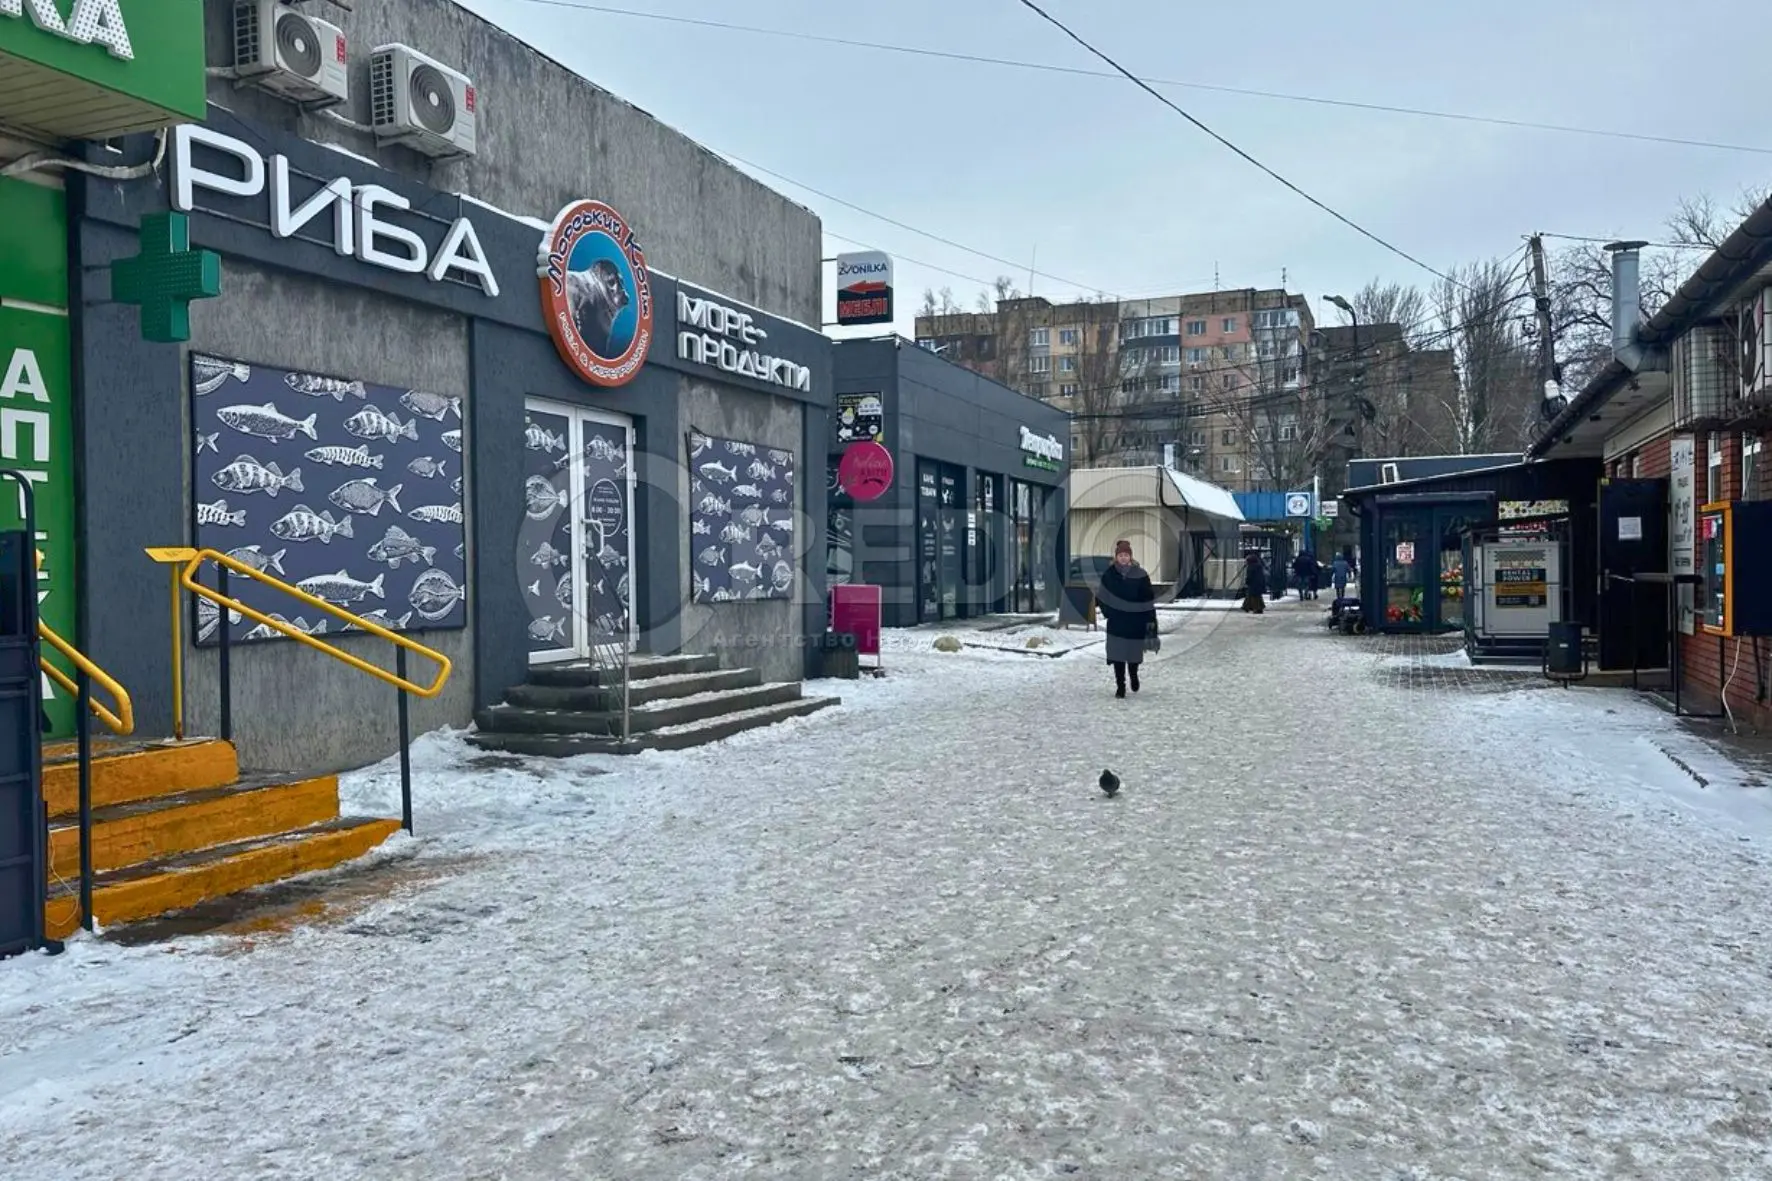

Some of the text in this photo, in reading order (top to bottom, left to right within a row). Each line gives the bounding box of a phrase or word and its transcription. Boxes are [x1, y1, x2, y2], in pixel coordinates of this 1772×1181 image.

[171, 123, 499, 297] РИБА
[838, 263, 888, 276] ZVONILKA
[677, 291, 768, 345] МОРЕ-
[677, 331, 811, 392] ПРОДУКТИ
